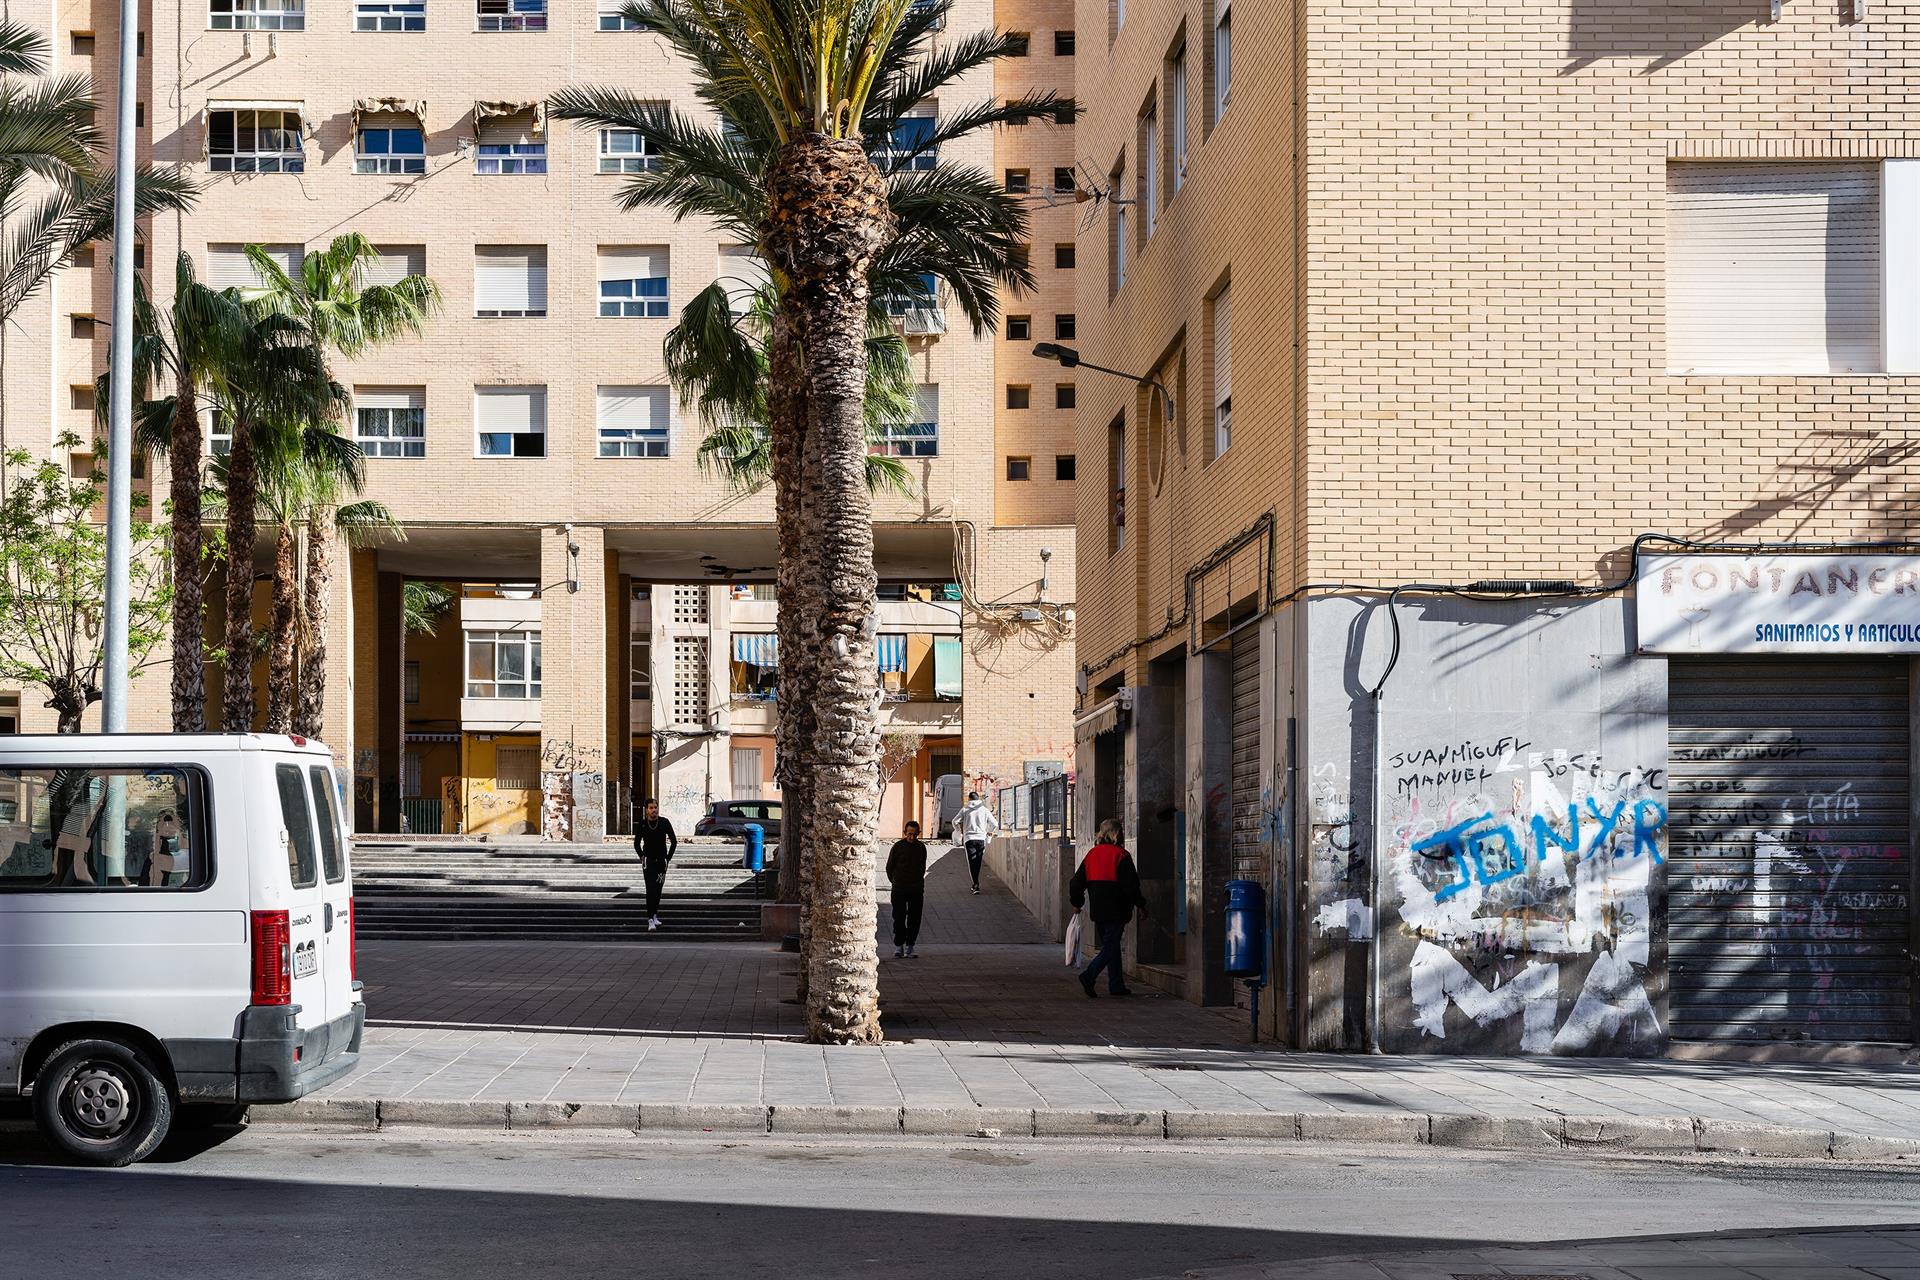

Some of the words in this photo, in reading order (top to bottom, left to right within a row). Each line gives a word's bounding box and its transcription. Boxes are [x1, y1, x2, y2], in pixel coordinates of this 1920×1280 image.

[1661, 565, 1918, 597] FONTANER
[1755, 623, 1840, 642] SANITARIOS
[1845, 623, 1854, 642] Y
[1398, 765, 1493, 796] MANUEL
